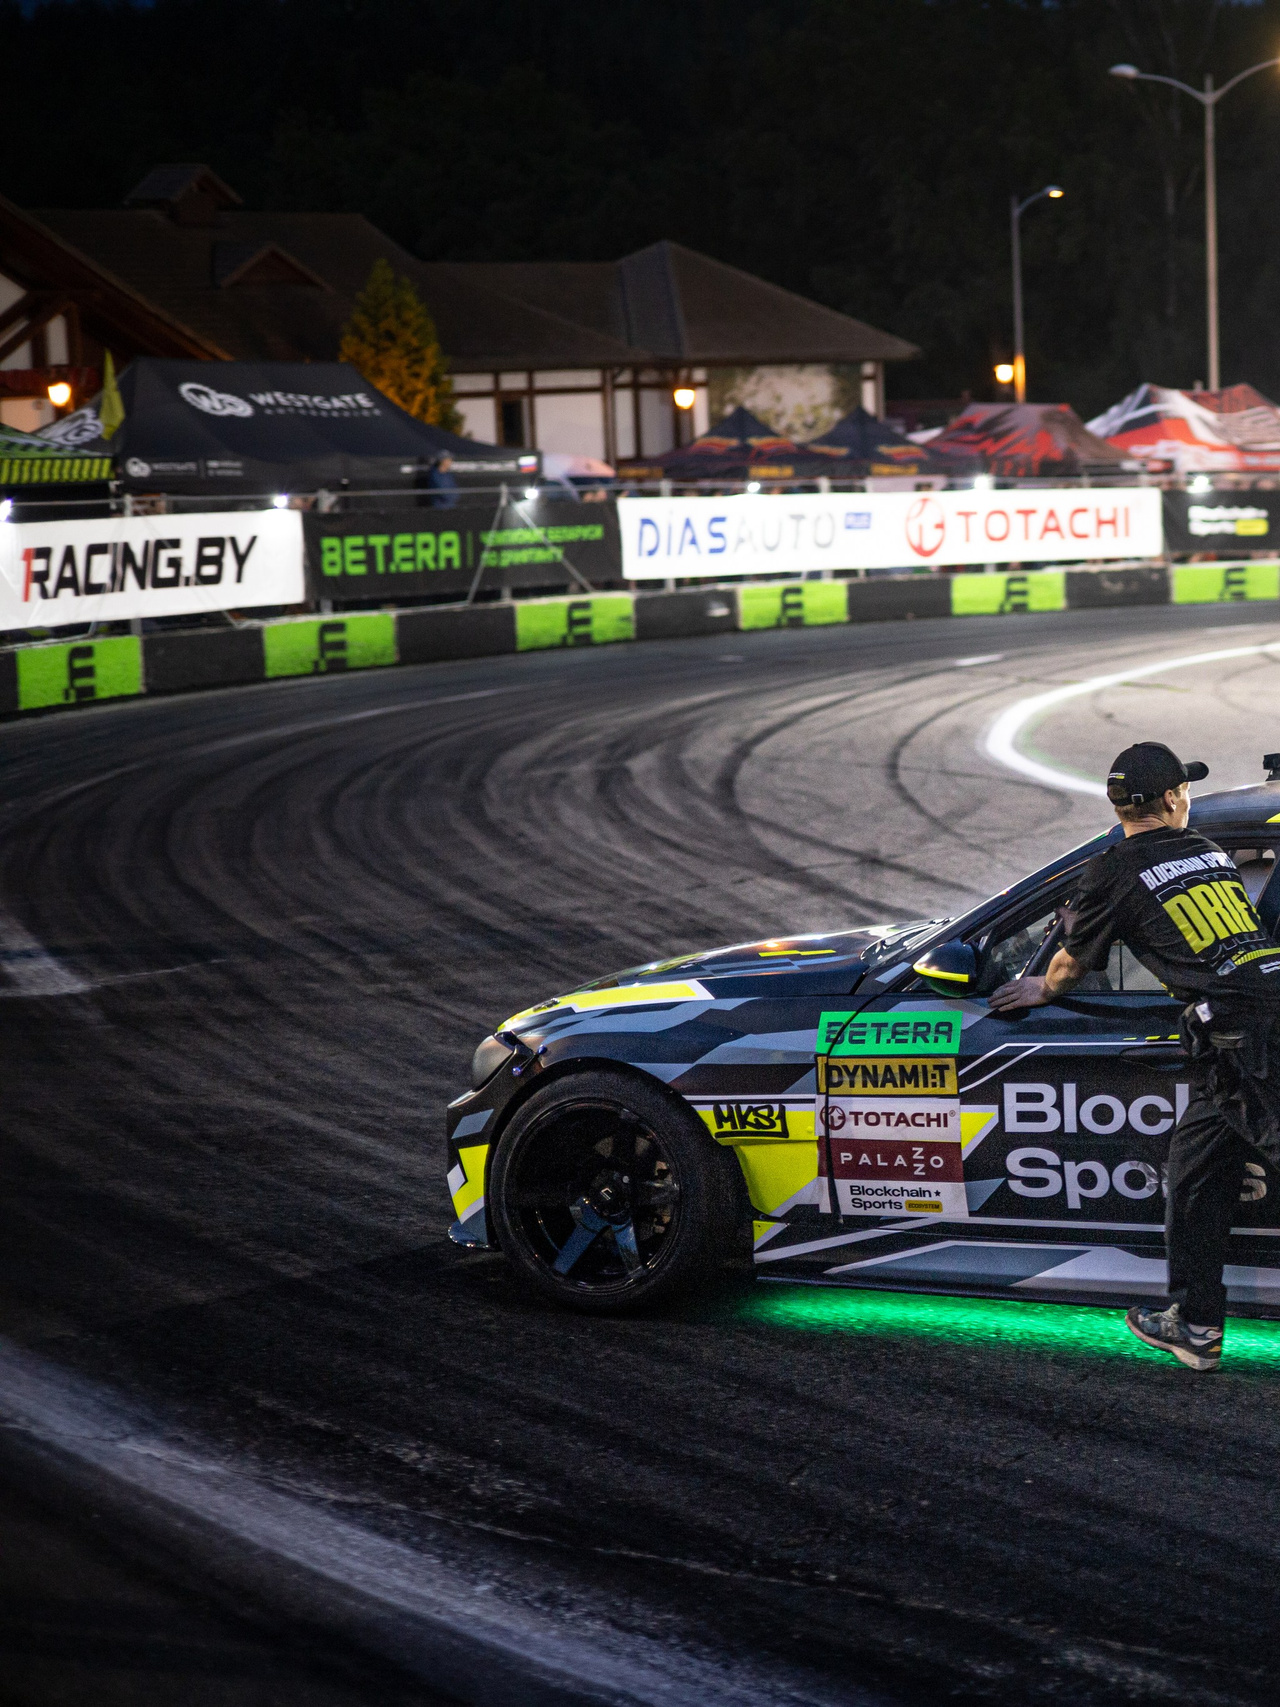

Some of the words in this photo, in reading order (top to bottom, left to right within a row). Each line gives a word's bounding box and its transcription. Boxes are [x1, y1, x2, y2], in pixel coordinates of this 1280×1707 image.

[250, 391, 374, 410] WESTGATE
[956, 507, 1131, 542] TOTACHI
[1139, 856, 1210, 891] BLOCKCHAIN
[840, 1147, 944, 1175] PALAZZO
[850, 1185, 932, 1198] Blockchain
[1006, 1147, 1268, 1209] Spos
[851, 1198, 903, 1210] Sports
